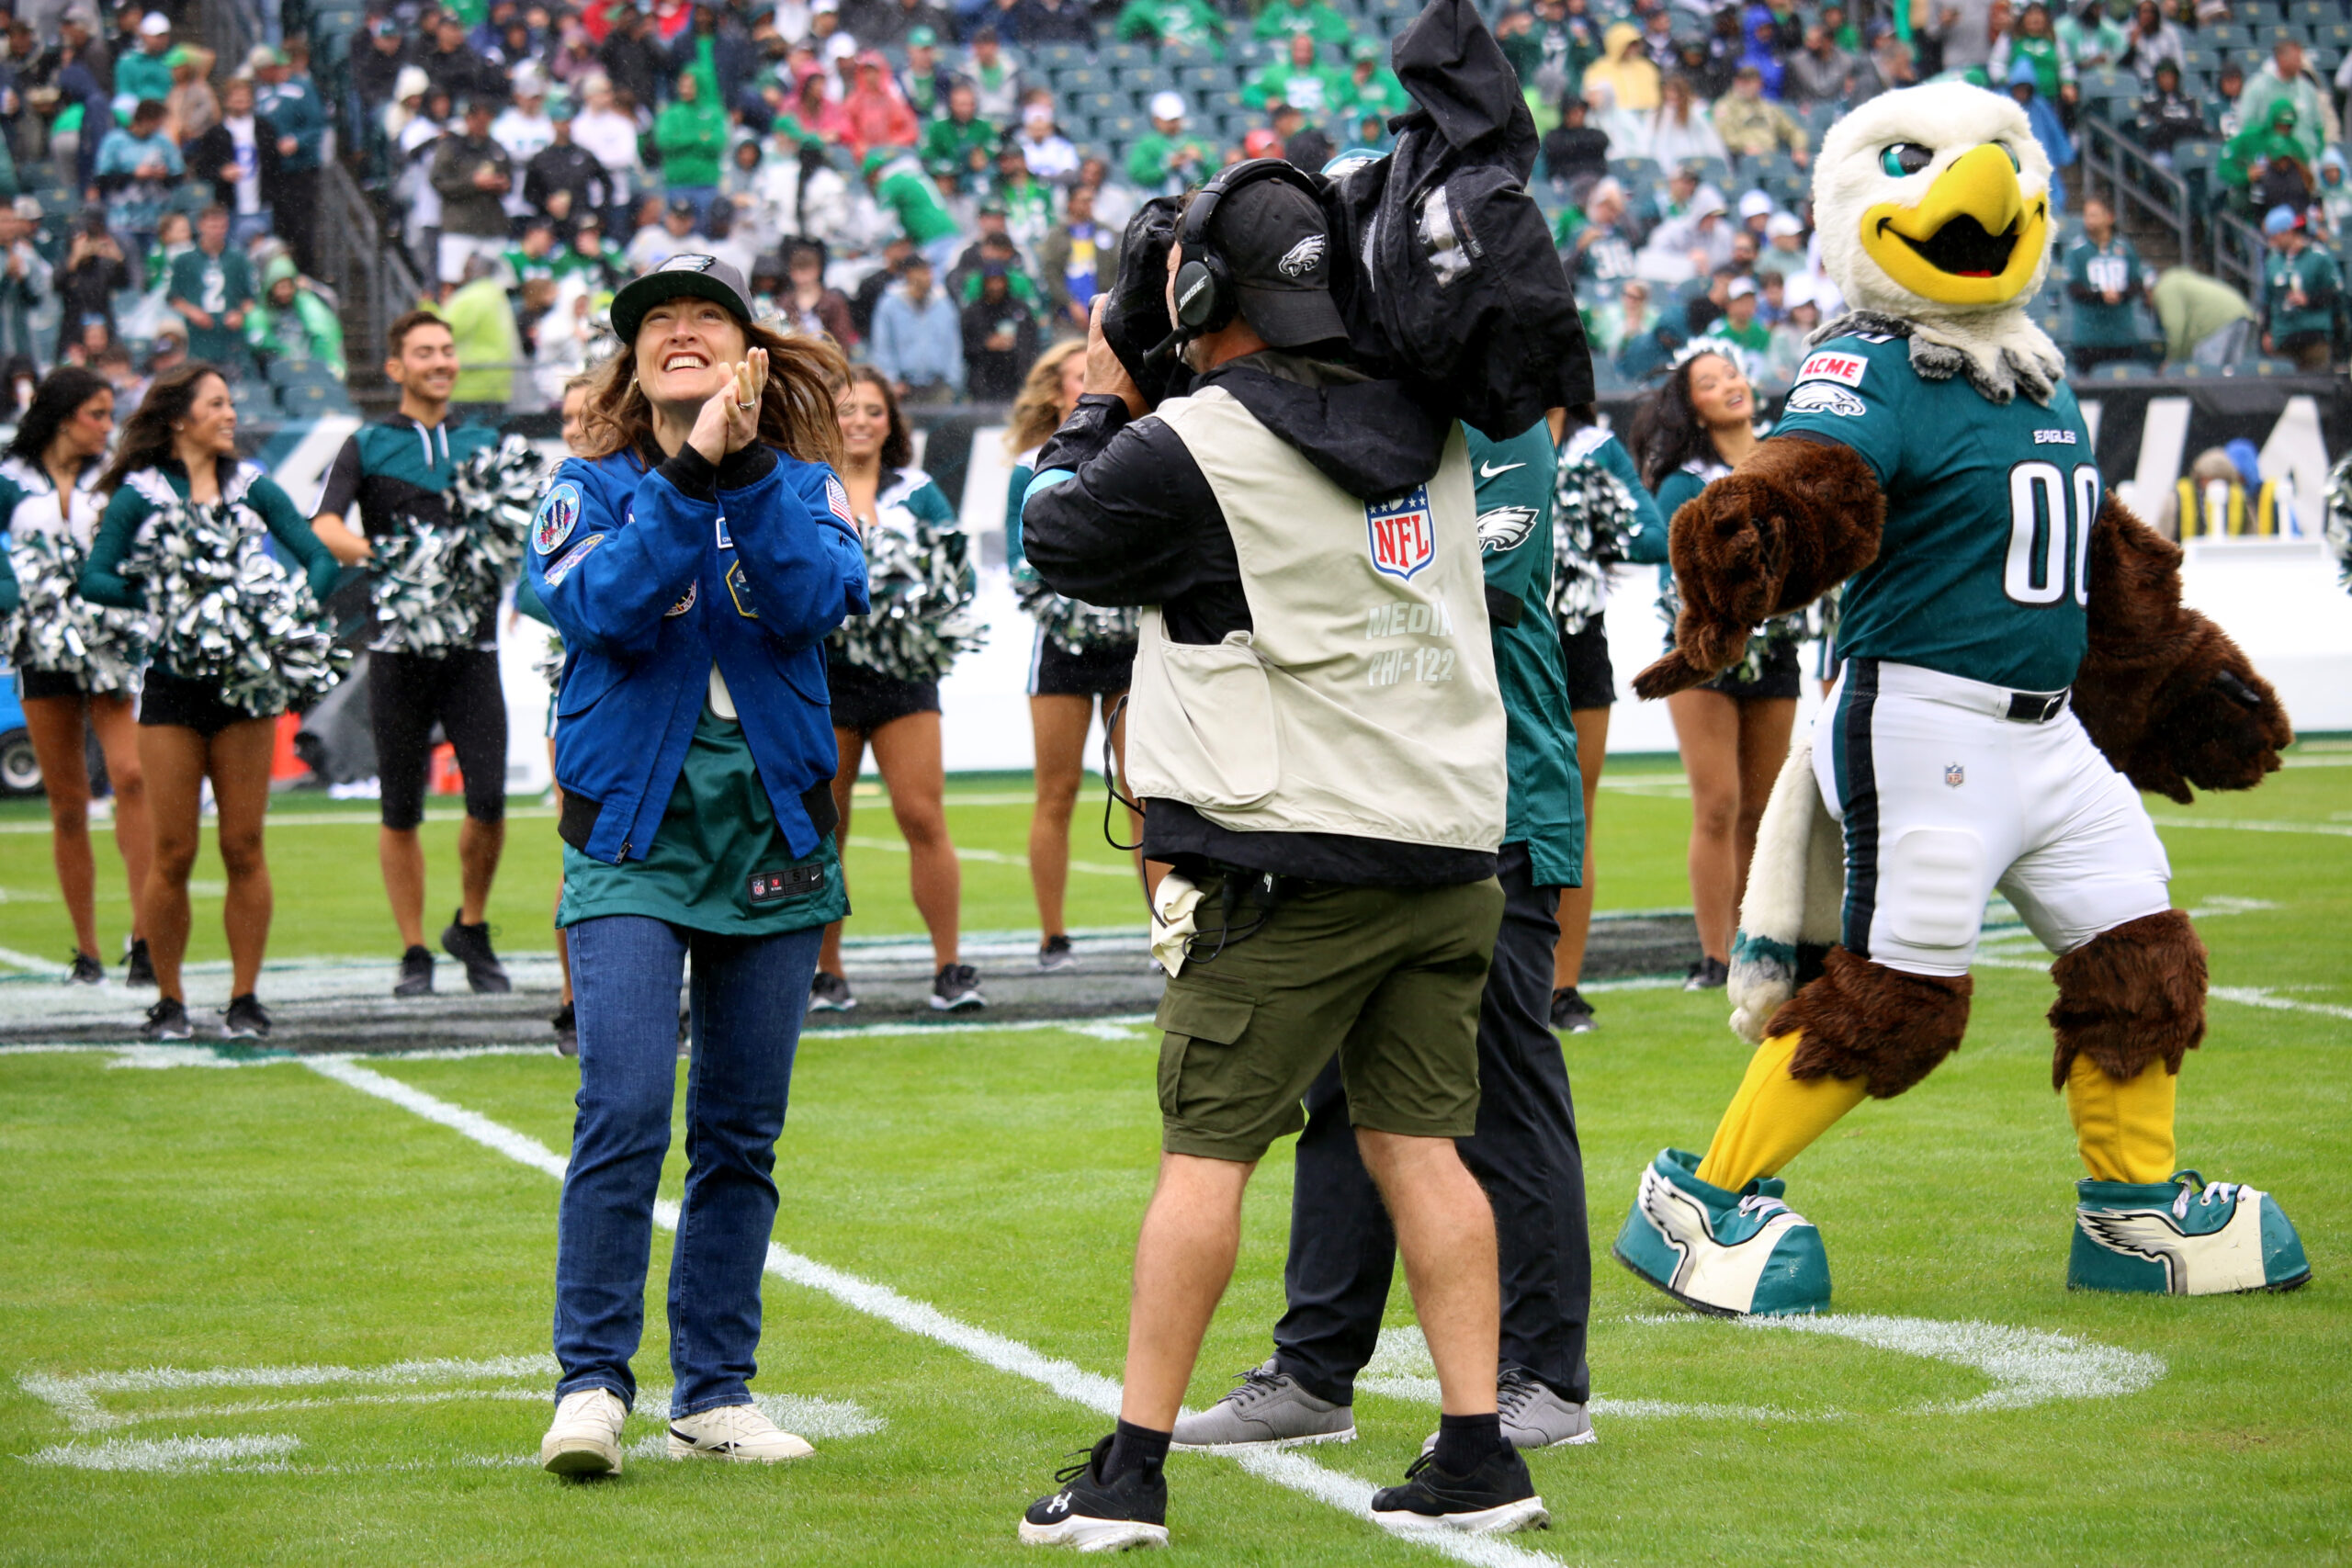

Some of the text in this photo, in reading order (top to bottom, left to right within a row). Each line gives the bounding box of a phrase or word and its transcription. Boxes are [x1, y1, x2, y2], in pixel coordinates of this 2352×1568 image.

[201, 267, 226, 313] 2
[1178, 275, 1208, 312] BOSE
[1803, 356, 1860, 378] ACME
[2032, 428, 2077, 445] EAGLES
[1374, 513, 1430, 569] NFL
[2003, 461, 2100, 607] 00
[1365, 600, 1455, 640] MEDIA
[1368, 646, 1456, 686] PHI-122
